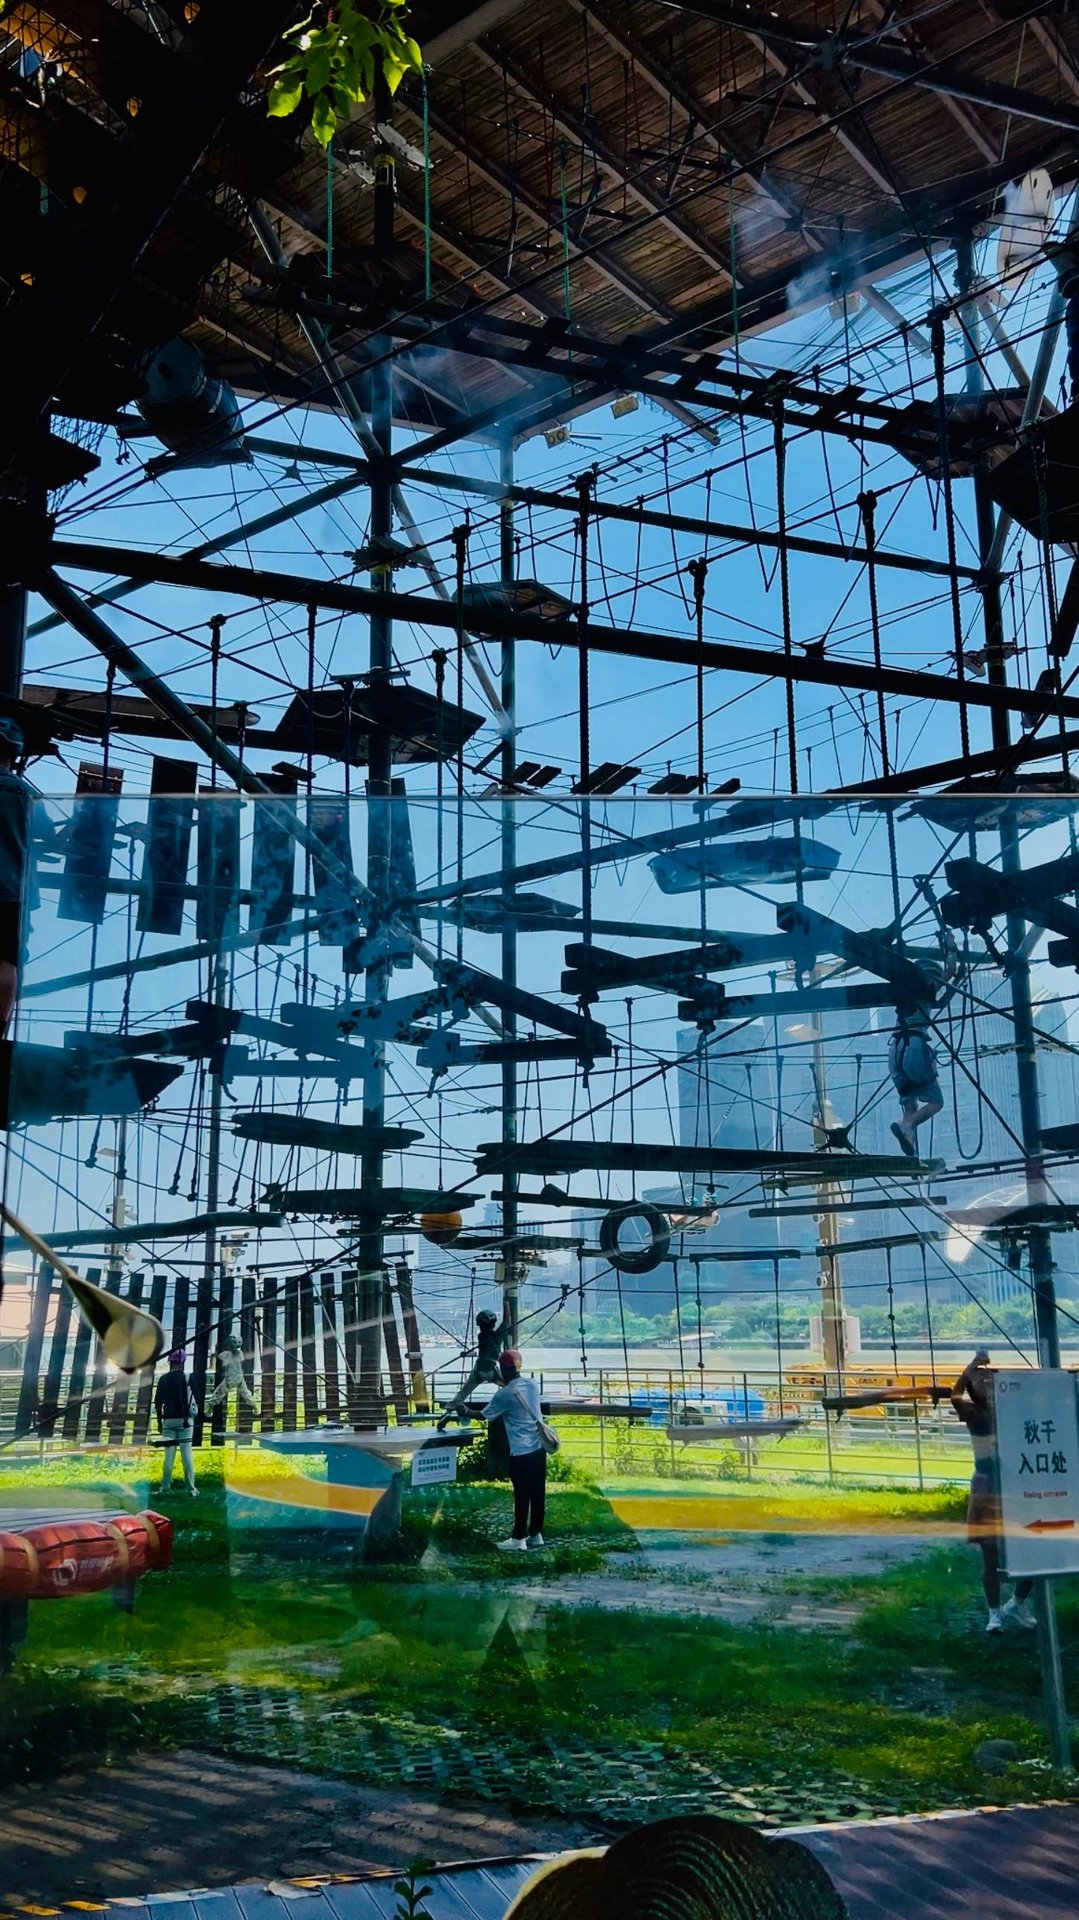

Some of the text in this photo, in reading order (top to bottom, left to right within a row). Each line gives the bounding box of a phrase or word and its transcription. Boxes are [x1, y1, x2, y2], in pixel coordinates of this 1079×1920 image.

[1024, 1419, 1056, 1444] 秋千
[1018, 1451, 1068, 1474] 入口处
